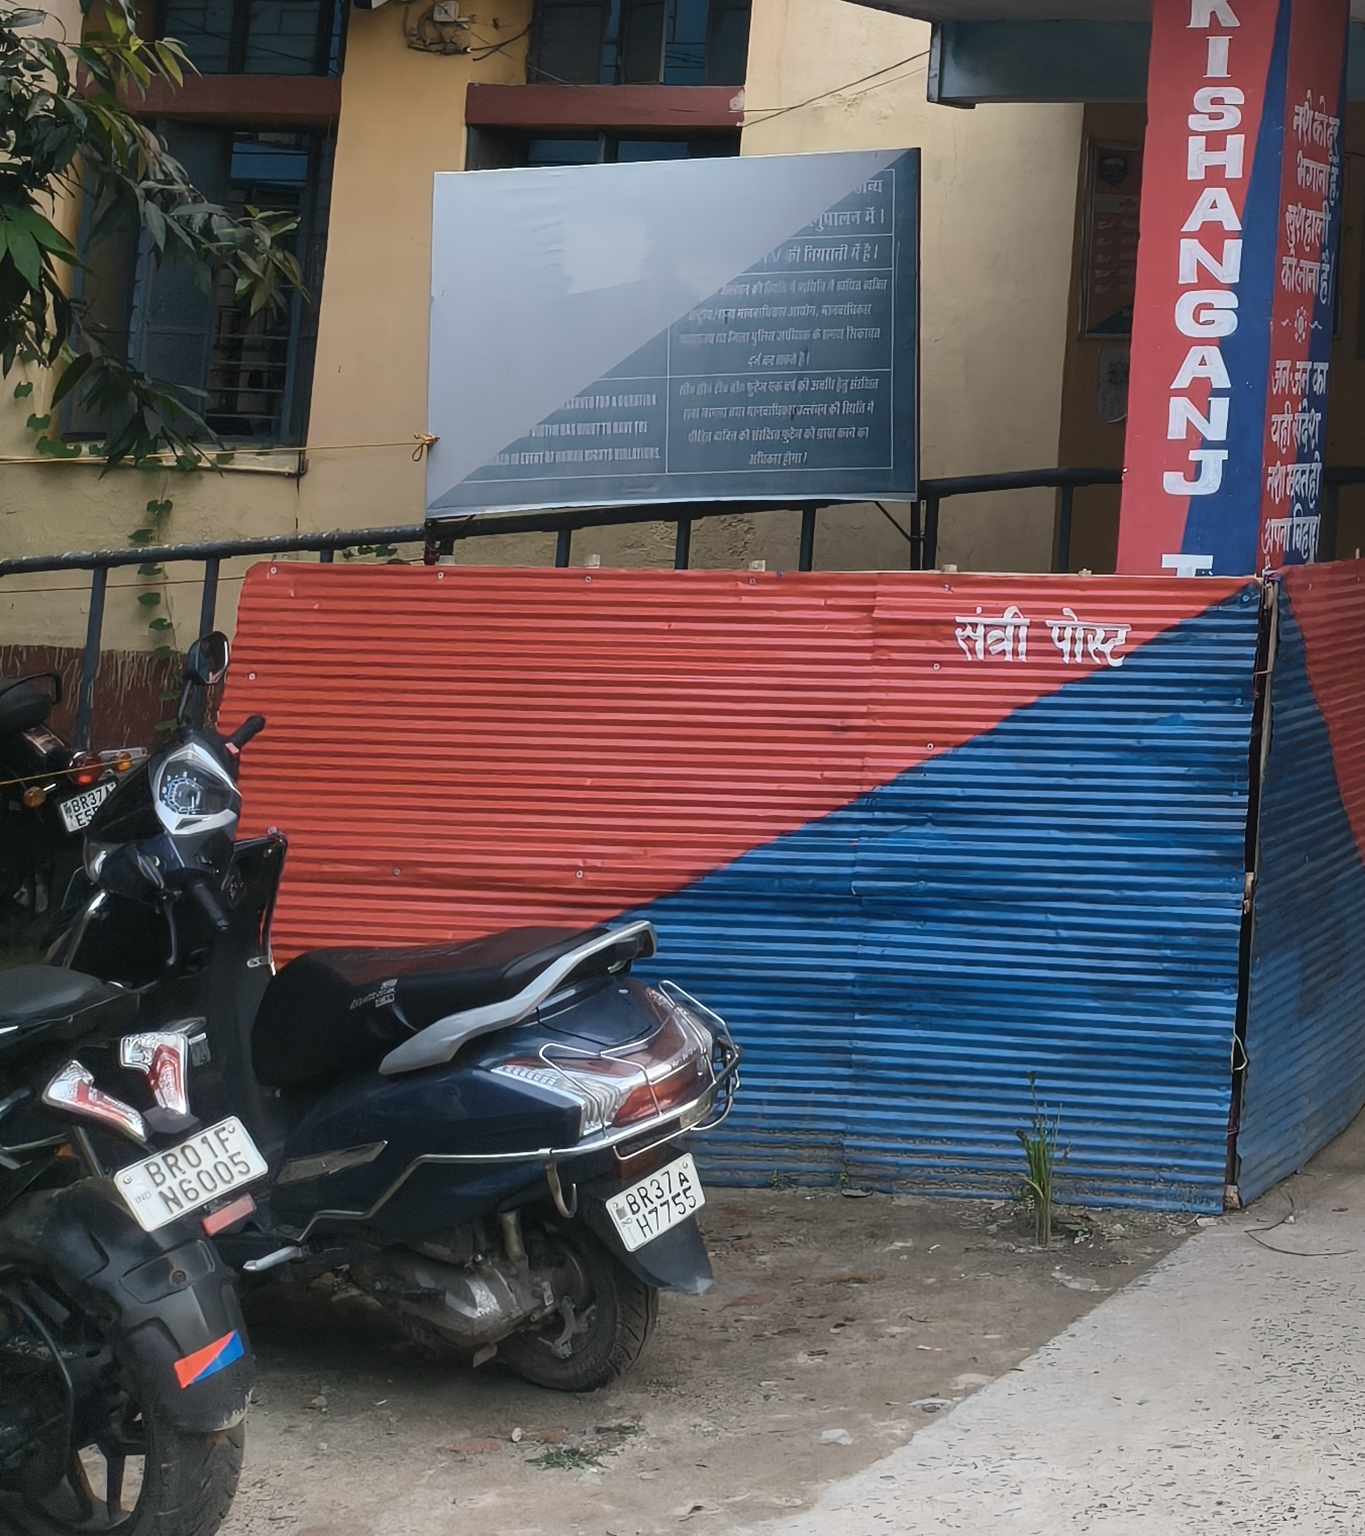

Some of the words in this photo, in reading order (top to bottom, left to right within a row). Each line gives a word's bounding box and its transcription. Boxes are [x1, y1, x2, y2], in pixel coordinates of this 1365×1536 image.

[955, 606, 1030, 662] संत्री
[1045, 607, 1131, 667] पोस्ट
[144, 1126, 230, 1188] BR01F
[157, 1151, 251, 1214] N6005
[134, 1190, 152, 1204] IND
[625, 1170, 689, 1215] BR37A
[635, 1185, 696, 1238] H7755
